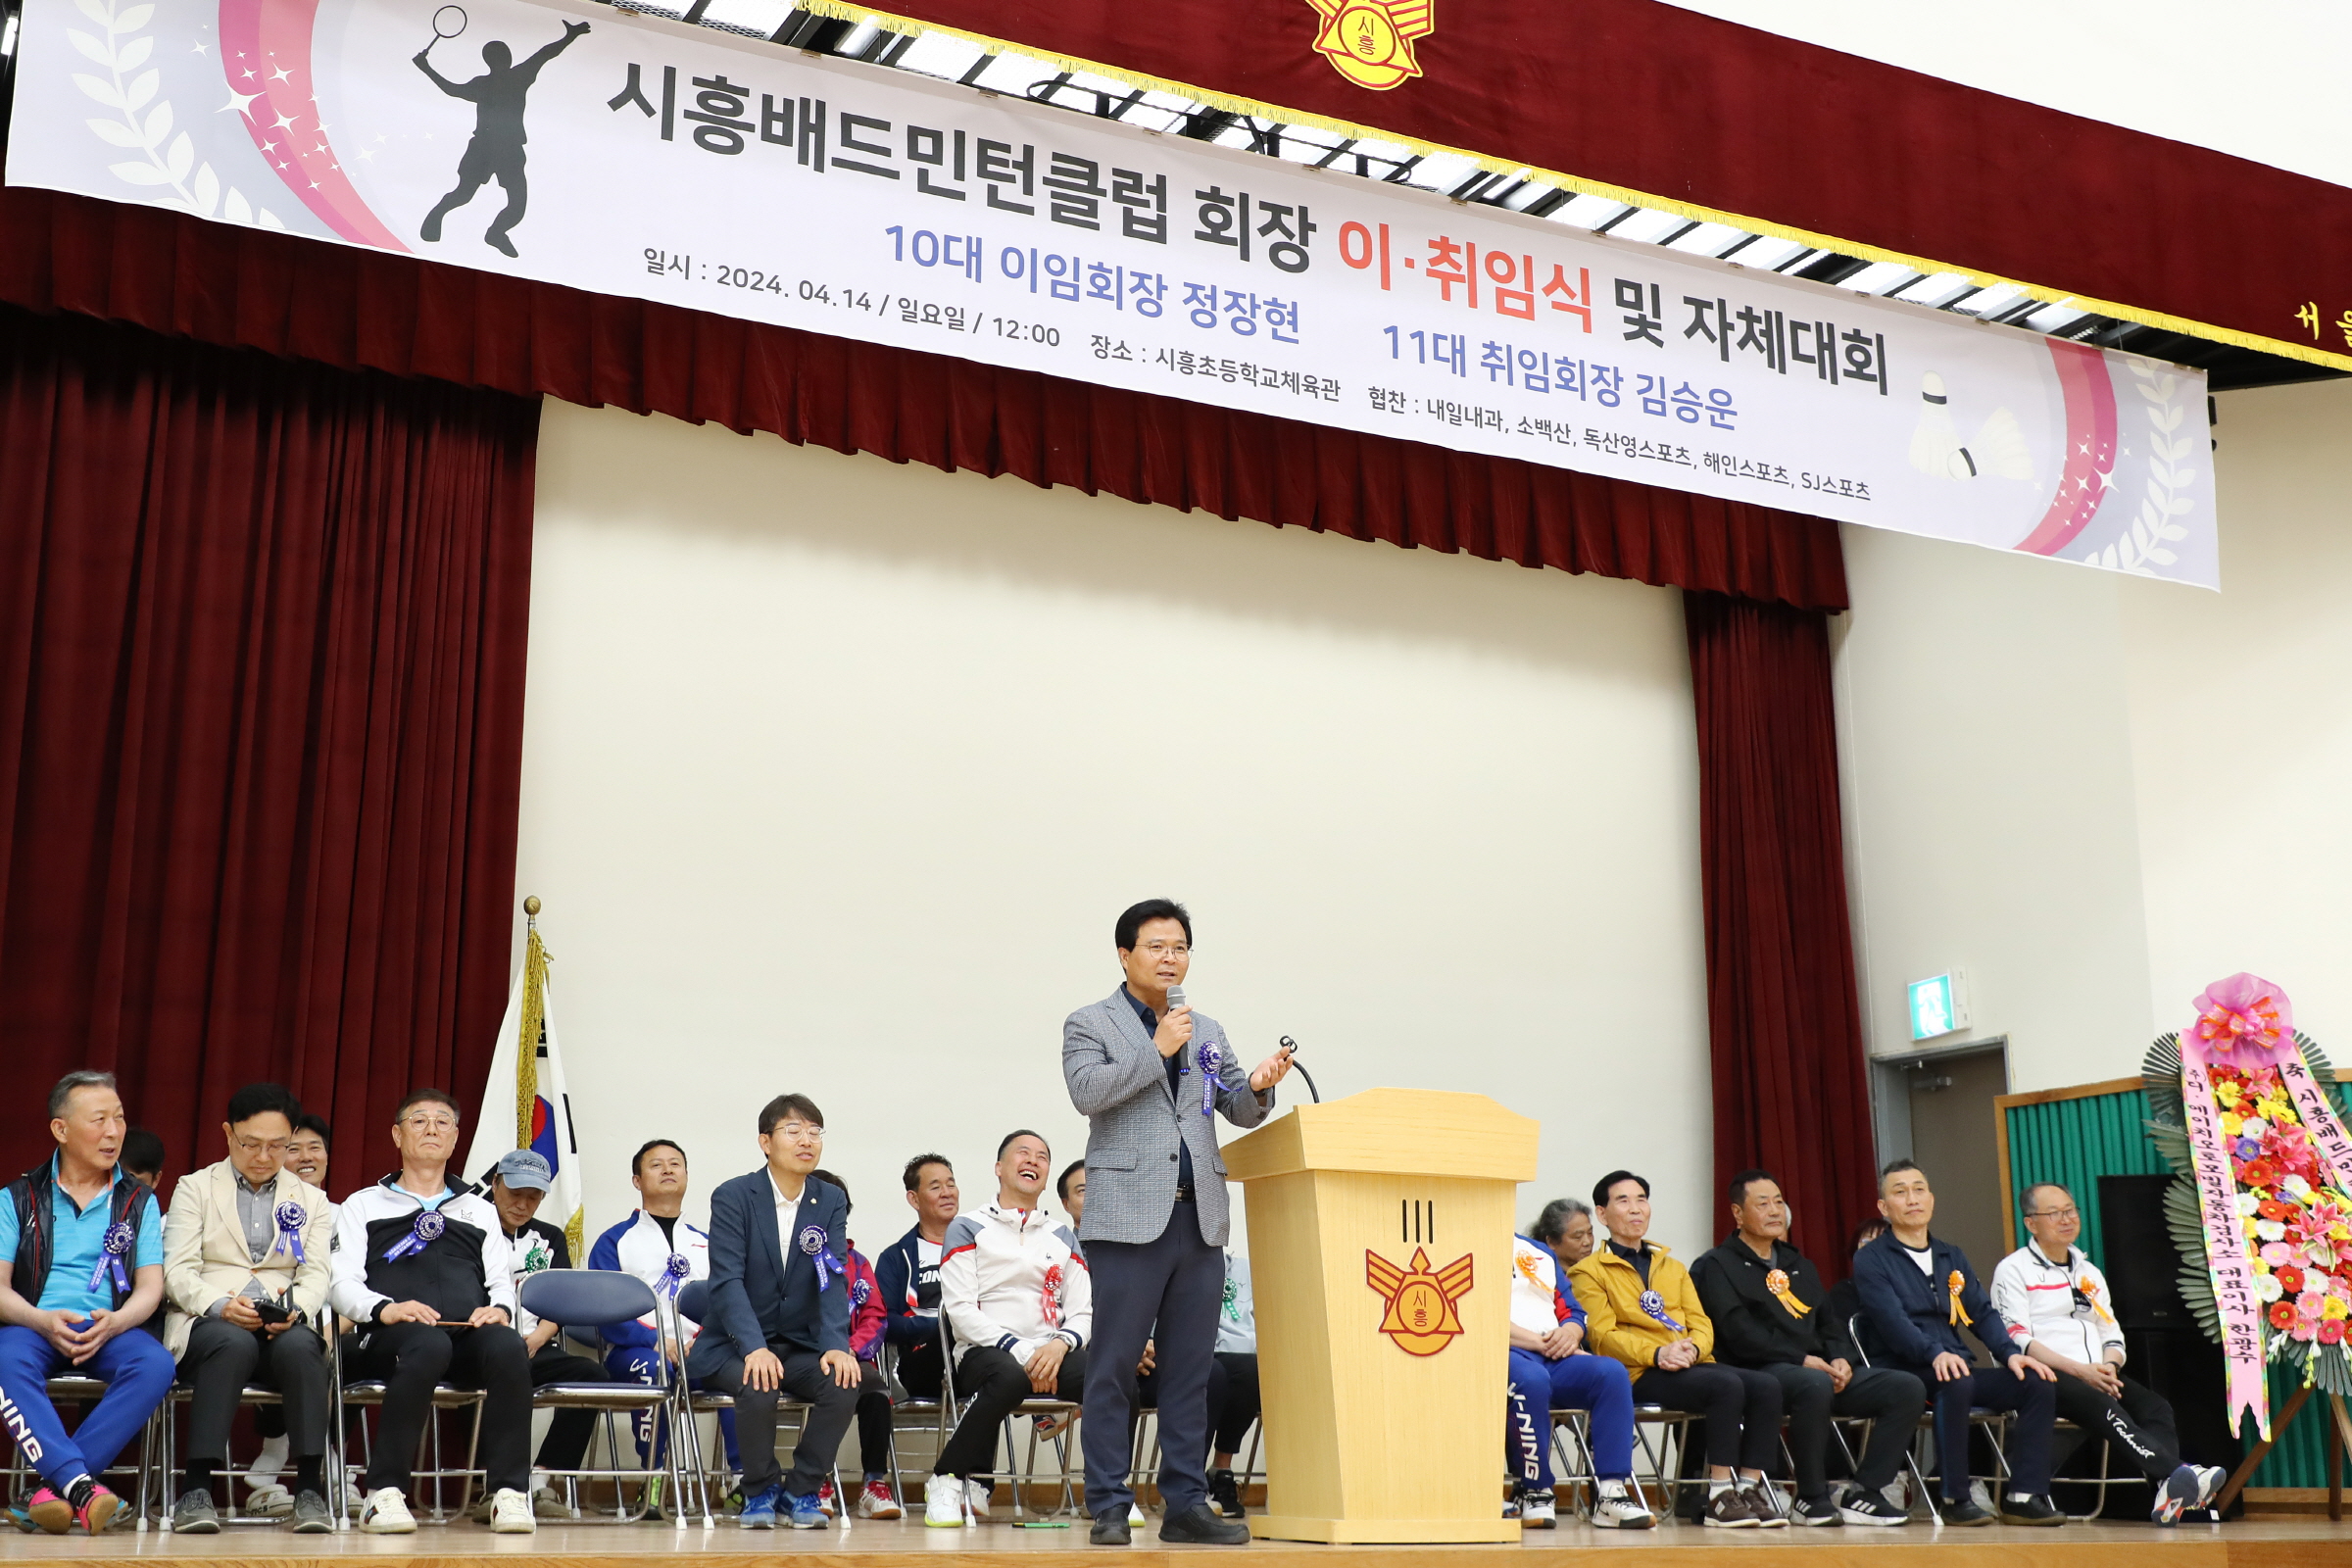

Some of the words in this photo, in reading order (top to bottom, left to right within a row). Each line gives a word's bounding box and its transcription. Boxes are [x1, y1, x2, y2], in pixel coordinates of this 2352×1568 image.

[1357, 16, 1376, 56] 시흥
[606, 62, 1168, 245] 시흥배드민턴클럽
[1194, 184, 1317, 273] 회장
[1338, 220, 1592, 334] 이·취임식
[1614, 277, 1665, 349] 및
[1683, 295, 1888, 397] 자체대회
[885, 224, 983, 284] 10대
[1001, 246, 1168, 318] 이임회장
[1182, 281, 1299, 345] 정장현
[1383, 325, 1466, 378] 11대
[1480, 340, 1624, 408] 취임회장
[1636, 373, 1738, 431] 김승운
[644, 247, 690, 280] 일시
[716, 265, 789, 298] 2024.
[799, 279, 872, 312] 04.14
[898, 297, 965, 332] 일요일
[993, 318, 1060, 347] 12:00
[1090, 334, 1133, 362] 장소
[1155, 348, 1342, 403] 시흥초등학교체육관
[1367, 385, 1407, 415] 협찬
[1427, 398, 1509, 434] 내일내과,
[1516, 416, 1577, 448] 소백산,
[1583, 427, 1700, 472] 독산영스포츠,
[1702, 451, 1797, 491] 해인스포츠,
[1801, 471, 1871, 502] SJ스포츠
[2285, 1062, 2305, 1079] 축
[1412, 1290, 1429, 1328] 시흥
[2217, 1266, 2256, 1316] 대표이사
[2227, 1323, 2258, 1365] 한광수
[2112, 1417, 2156, 1459] Technist
